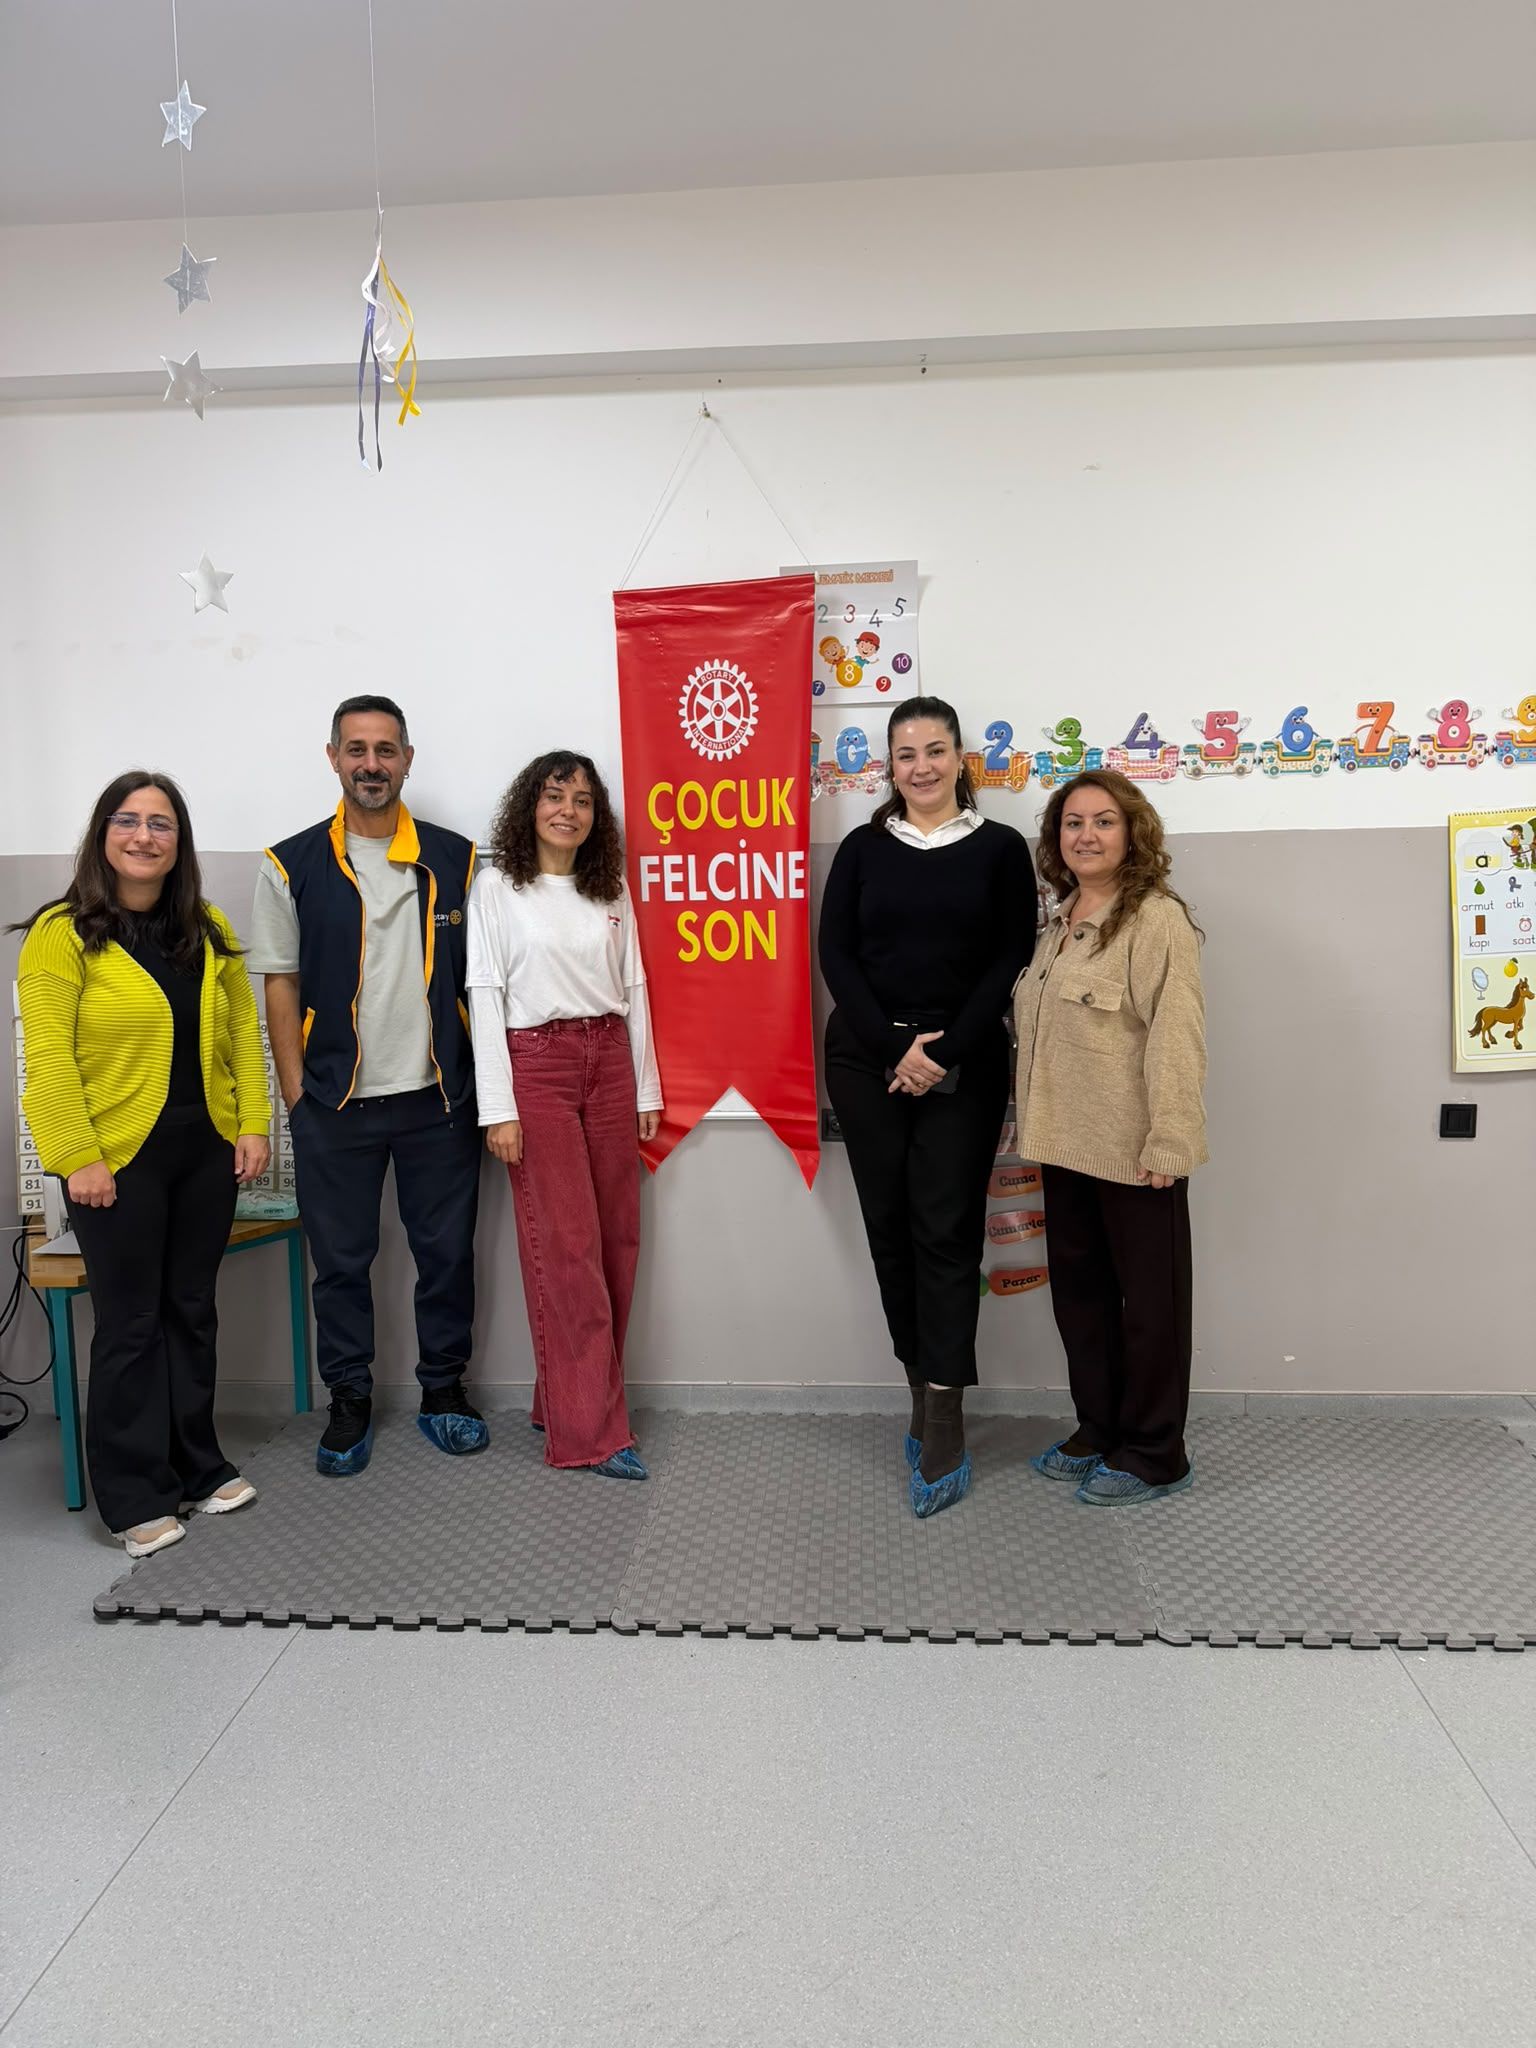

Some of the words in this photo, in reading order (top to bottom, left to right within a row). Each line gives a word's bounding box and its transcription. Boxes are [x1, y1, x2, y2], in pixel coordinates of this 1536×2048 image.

[817, 604, 829, 623] 2
[843, 604, 856, 623] 3
[868, 608, 883, 628] 4
[891, 597, 907, 618] 5
[896, 656, 908, 669] 10
[700, 670, 734, 684] ROTARY
[844, 664, 855, 681] 8
[814, 682, 821, 693] 7
[879, 678, 888, 690] 9
[691, 725, 748, 750] INTERNATIONAL
[984, 720, 1014, 770] 2
[1055, 717, 1083, 766] 3
[1125, 712, 1162, 759] 4
[1203, 711, 1239, 757] 5
[1282, 706, 1314, 752] 6
[1357, 701, 1395, 753] 7
[1437, 699, 1472, 749] 8
[647, 777, 796, 845] ÇOCUK
[1475, 854, 1489, 868] a
[639, 838, 805, 902] FELCİNE
[1461, 900, 1495, 912] armut
[1505, 897, 1524, 909] atkı
[433, 913, 449, 921] otary
[676, 909, 778, 962] SON
[1469, 935, 1490, 951] kapı
[1512, 935, 1536, 946] saat
[25, 1159, 41, 1170] 71
[25, 1178, 41, 1190] 81
[255, 1176, 270, 1187] 89
[999, 1173, 1037, 1187] Cuma
[26, 1198, 42, 1210] 91
[988, 1217, 1047, 1238] Cumarte
[1002, 1273, 1041, 1288] Pazar
